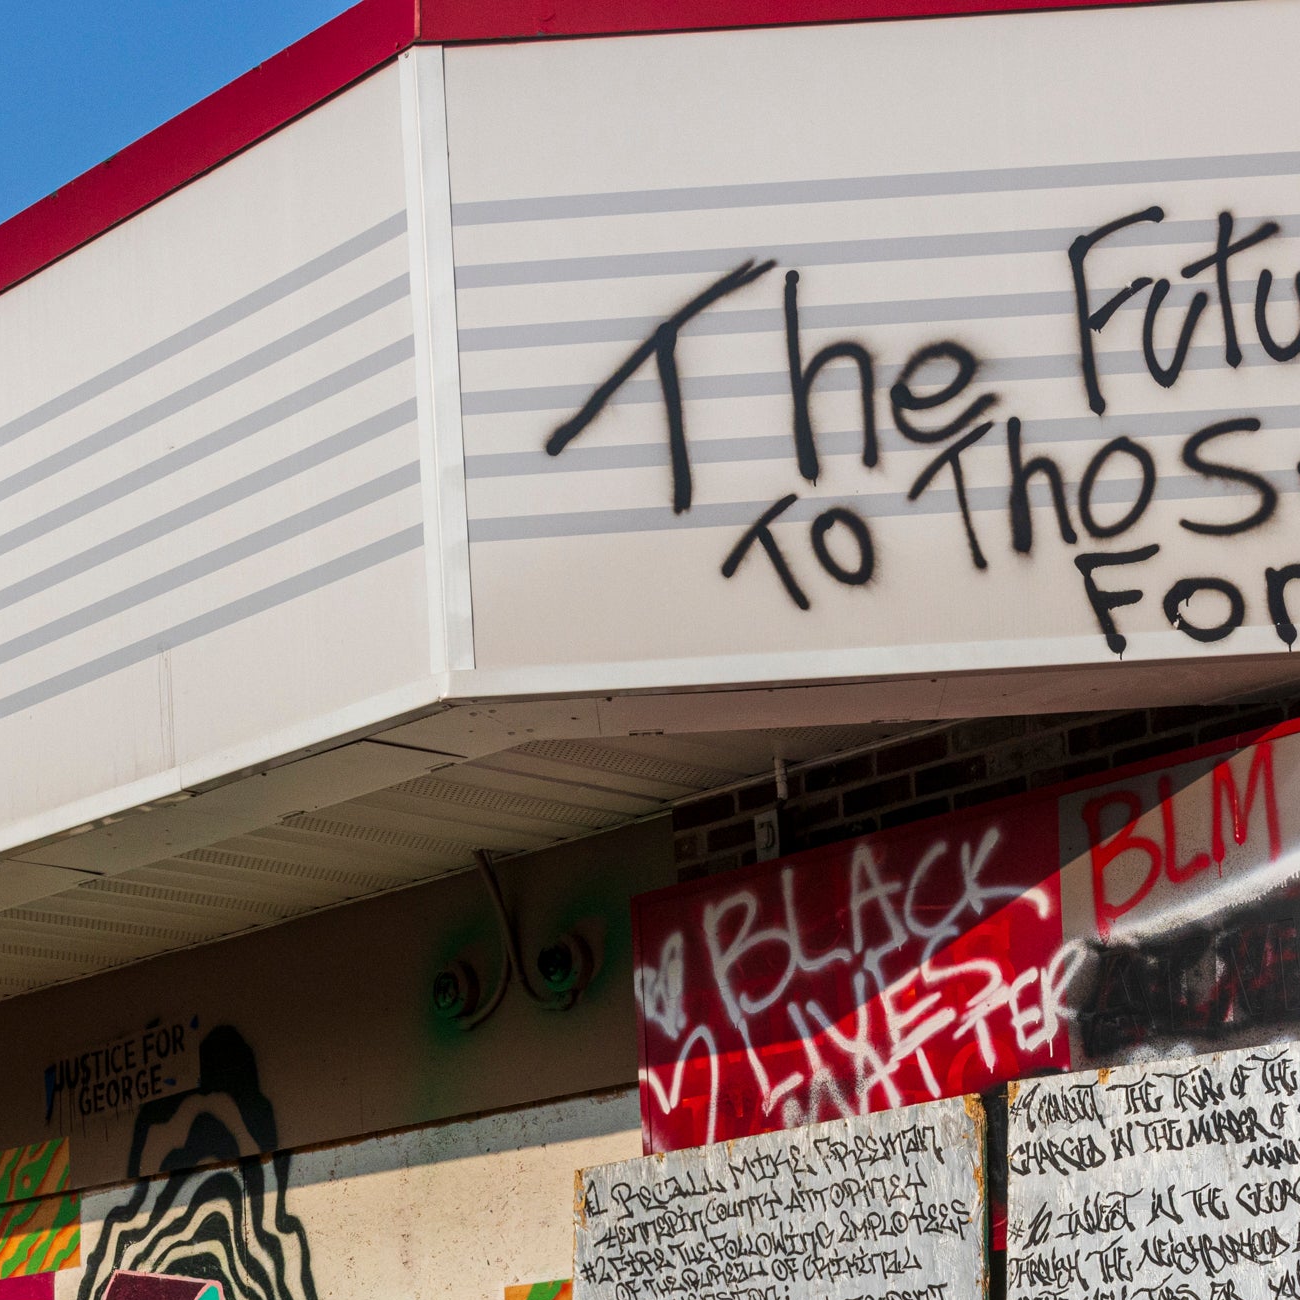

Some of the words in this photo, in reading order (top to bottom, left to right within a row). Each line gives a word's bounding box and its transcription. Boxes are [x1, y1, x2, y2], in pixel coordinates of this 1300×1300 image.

[544, 256, 1000, 516] The
[720, 492, 877, 612] To
[1086, 742, 1283, 936] BLM
[705, 827, 1050, 1028] BLACK
[53, 1040, 136, 1092] JUSTICE
[142, 1024, 185, 1064] FOR
[79, 1064, 162, 1115] GEORGE
[1106, 1073, 1164, 1115] THE
[1230, 1065, 1256, 1097] OF
[1246, 1049, 1298, 1096] THE
[1135, 1118, 1183, 1152] THE
[1270, 1102, 1288, 1130] OF
